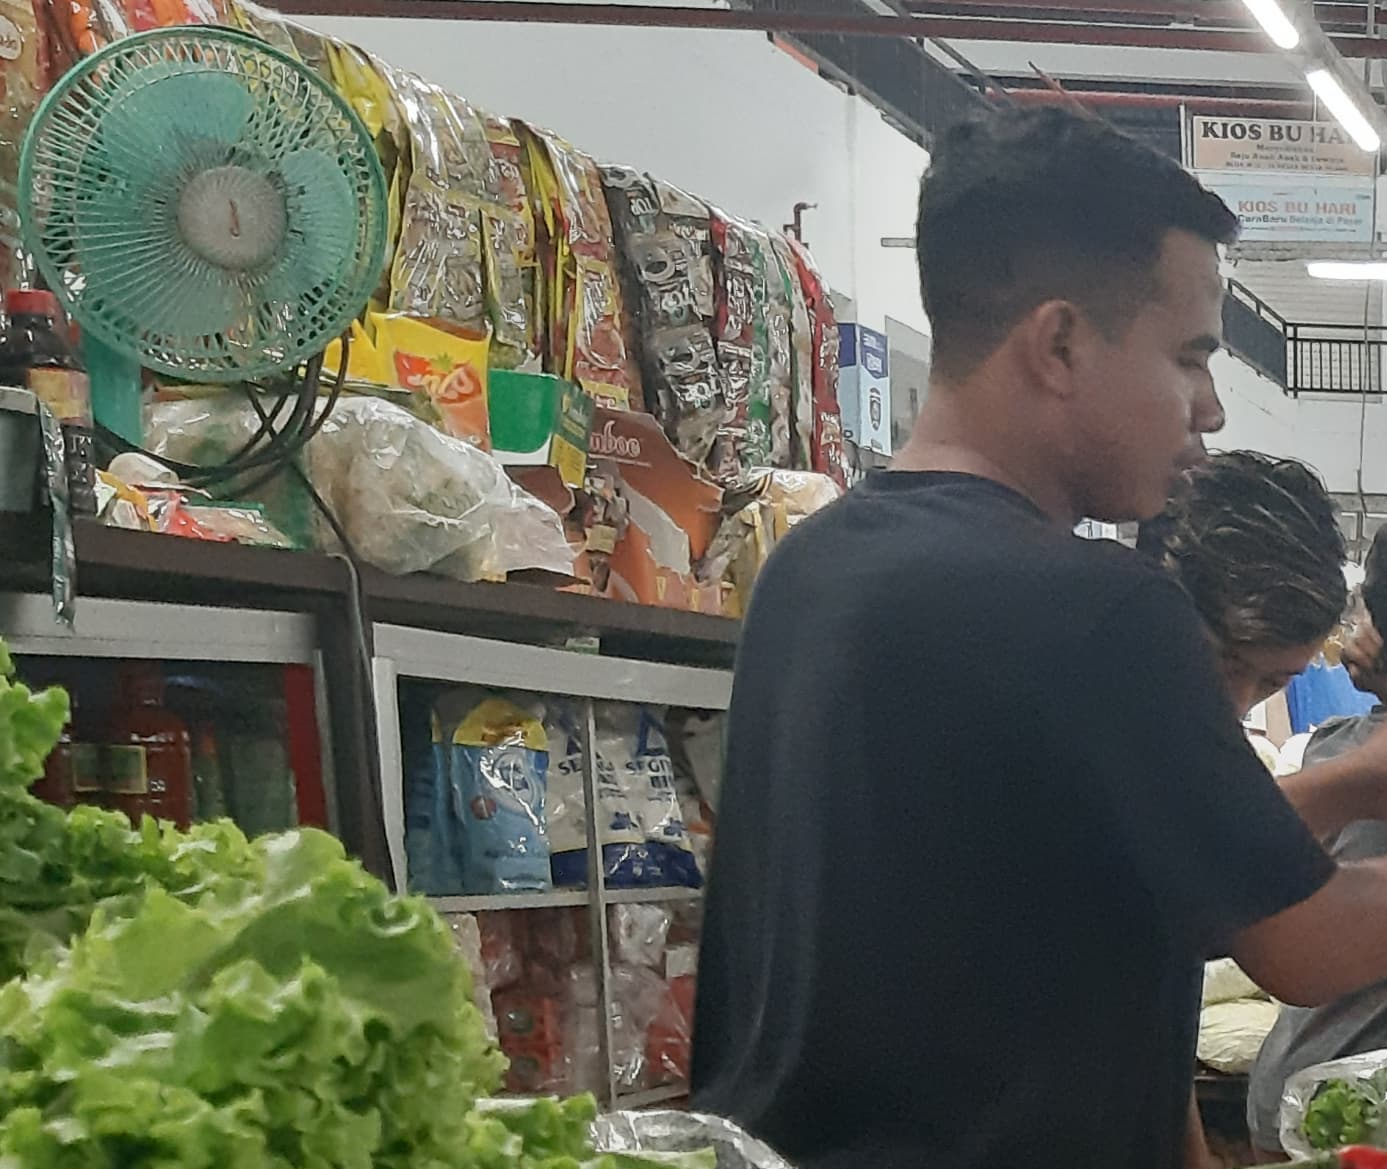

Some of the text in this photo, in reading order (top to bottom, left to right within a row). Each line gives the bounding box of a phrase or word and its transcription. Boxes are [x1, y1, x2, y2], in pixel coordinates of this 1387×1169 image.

[1201, 121, 1354, 144] KIOS BU HA
[1238, 200, 1357, 216] KIOS BU HARI
